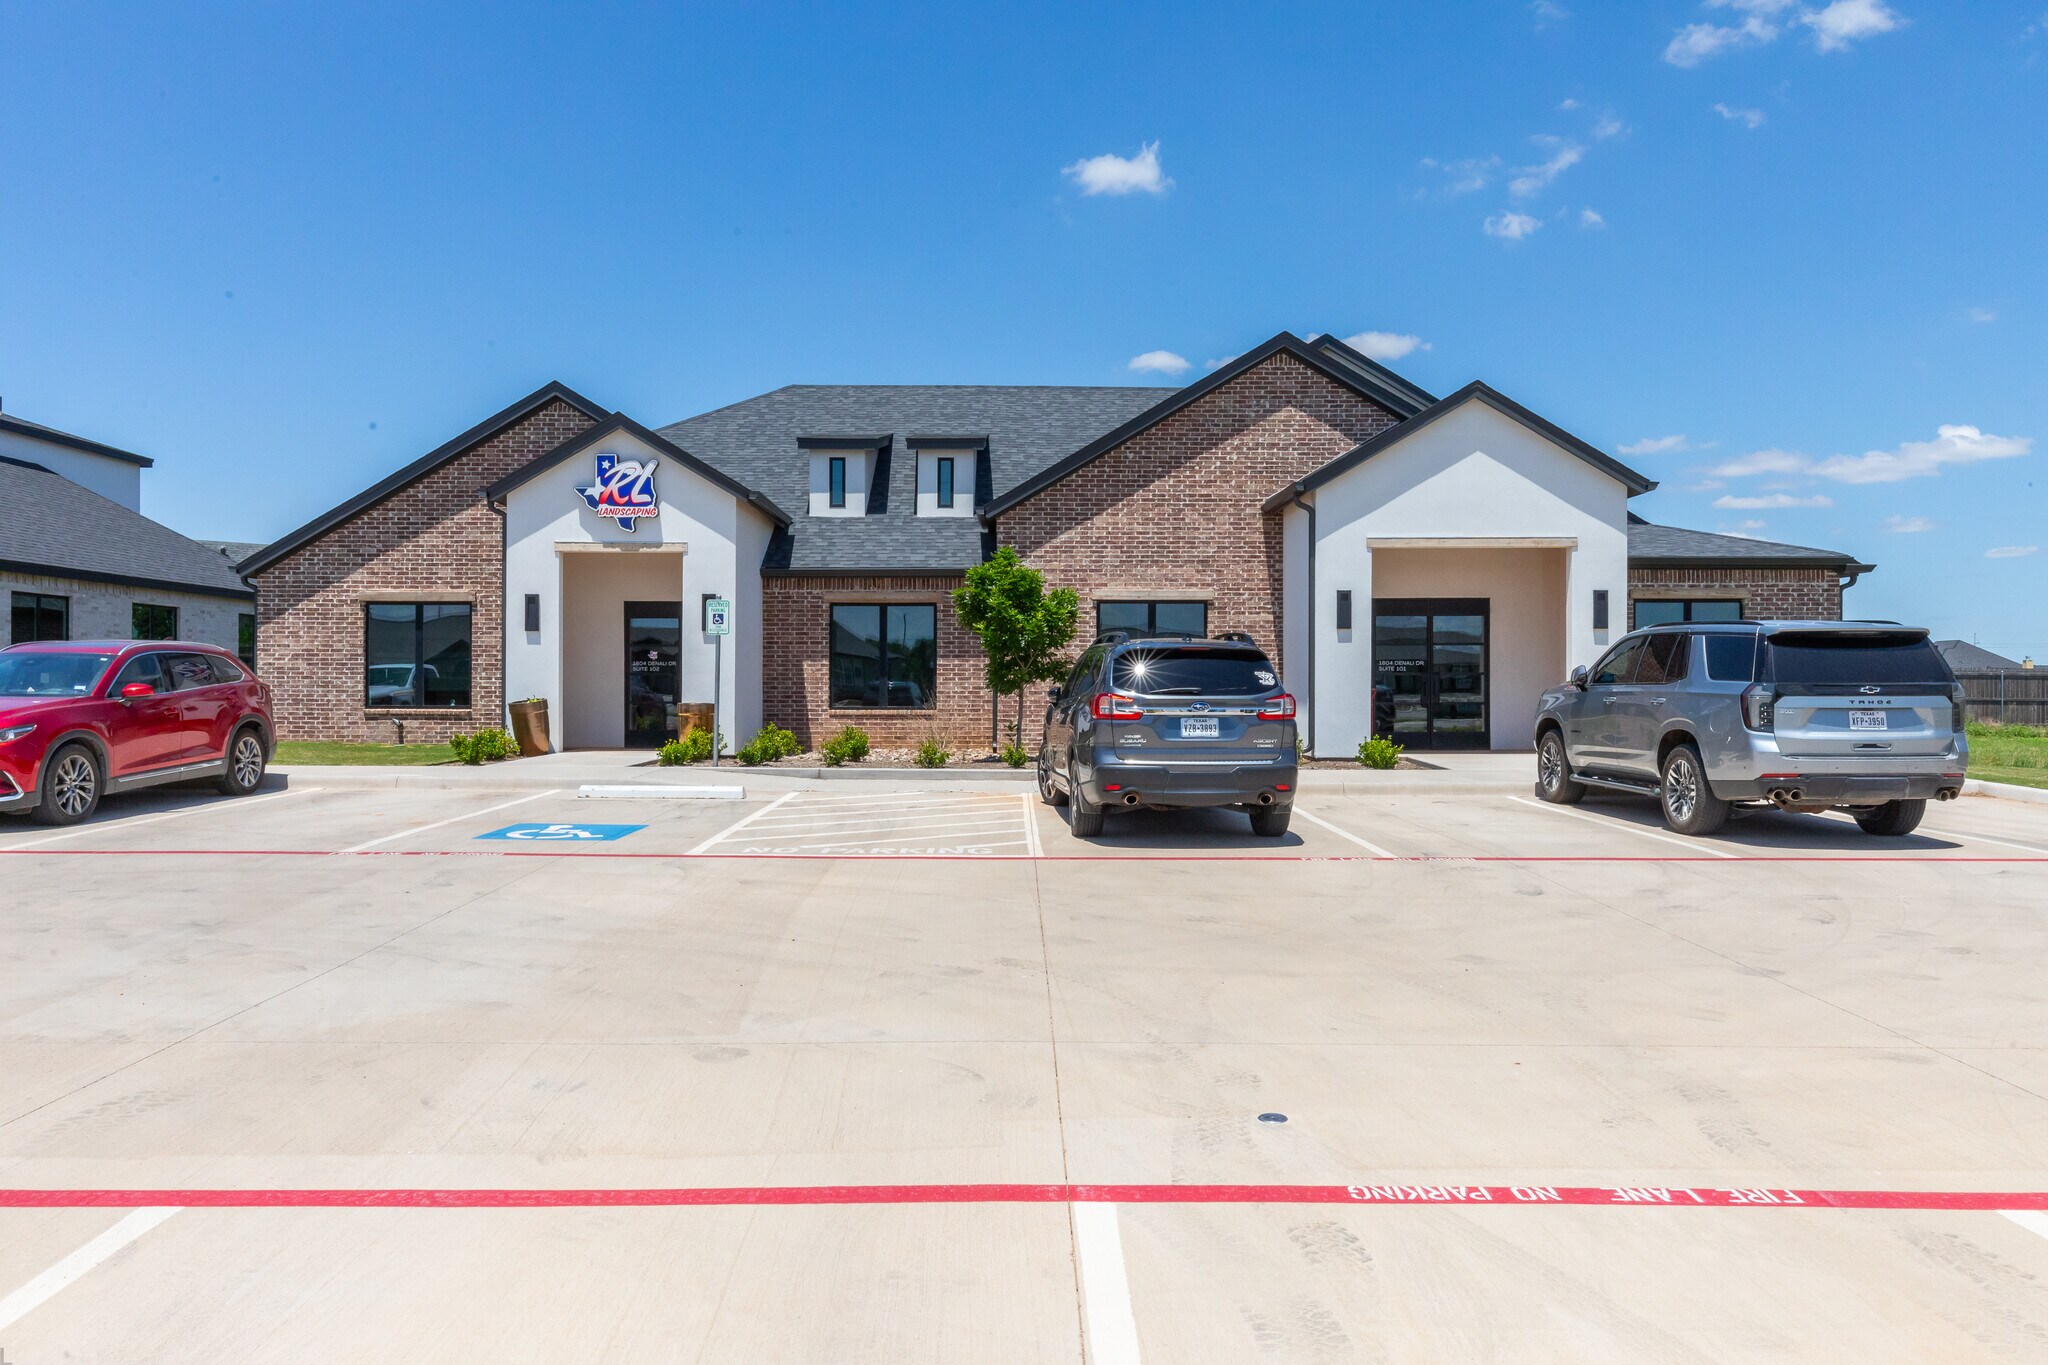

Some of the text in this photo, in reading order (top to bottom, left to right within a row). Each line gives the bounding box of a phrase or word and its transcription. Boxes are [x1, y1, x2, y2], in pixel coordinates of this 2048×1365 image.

[599, 459, 658, 505] RL
[598, 507, 657, 516] LANDSCAPING
[820, 847, 995, 855] PARKING
[1347, 1185, 1805, 1205] FIRE LANE NO PARKING
